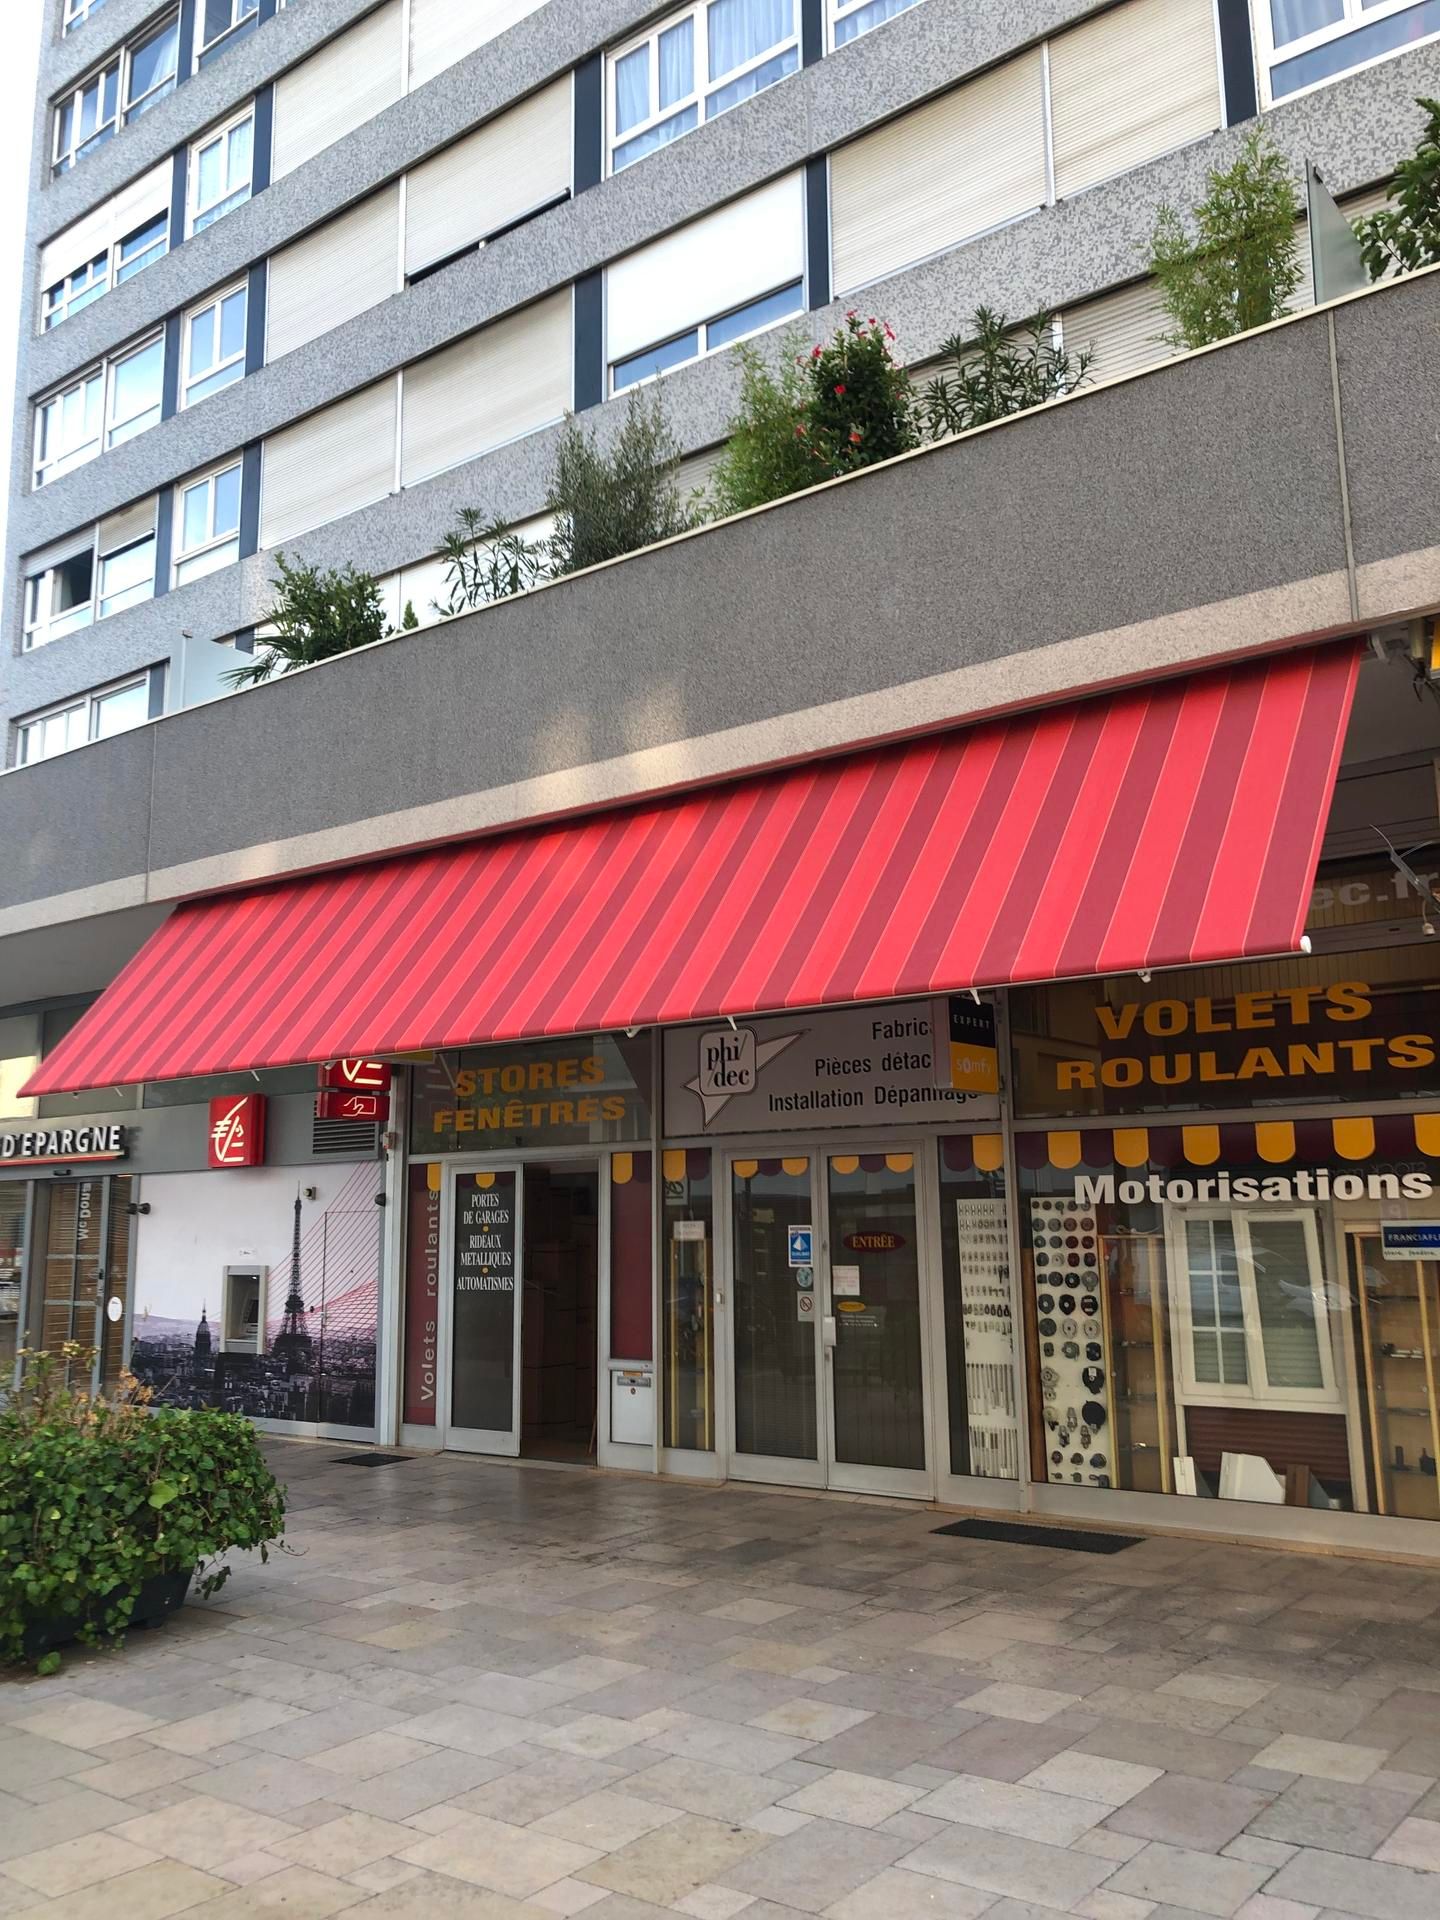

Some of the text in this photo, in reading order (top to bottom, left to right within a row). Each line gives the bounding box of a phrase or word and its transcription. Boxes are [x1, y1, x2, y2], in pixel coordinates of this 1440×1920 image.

[953, 1014, 990, 1029] EXPERT
[1095, 981, 1372, 1040] VOLETS
[872, 1018, 934, 1040] Fabric
[815, 1057, 872, 1077] Pièces
[956, 1056, 992, 1077] somfy
[1056, 1034, 1436, 1090] ROULANTS
[456, 1056, 606, 1097] STORES
[769, 1088, 863, 1112] Installation
[433, 1096, 625, 1133] FENÊTRES
[2, 1125, 122, 1158] D'EPARGNE
[1074, 1168, 1433, 1205] Motorisations
[471, 1193, 500, 1208] PORTES
[463, 1209, 510, 1225] DE GARAGES
[469, 1234, 502, 1249] RIDEAUX
[460, 1251, 512, 1269] METALLIQUES
[456, 1276, 514, 1291] AUTOMATISMES
[420, 1190, 439, 1401] Volets roulants
